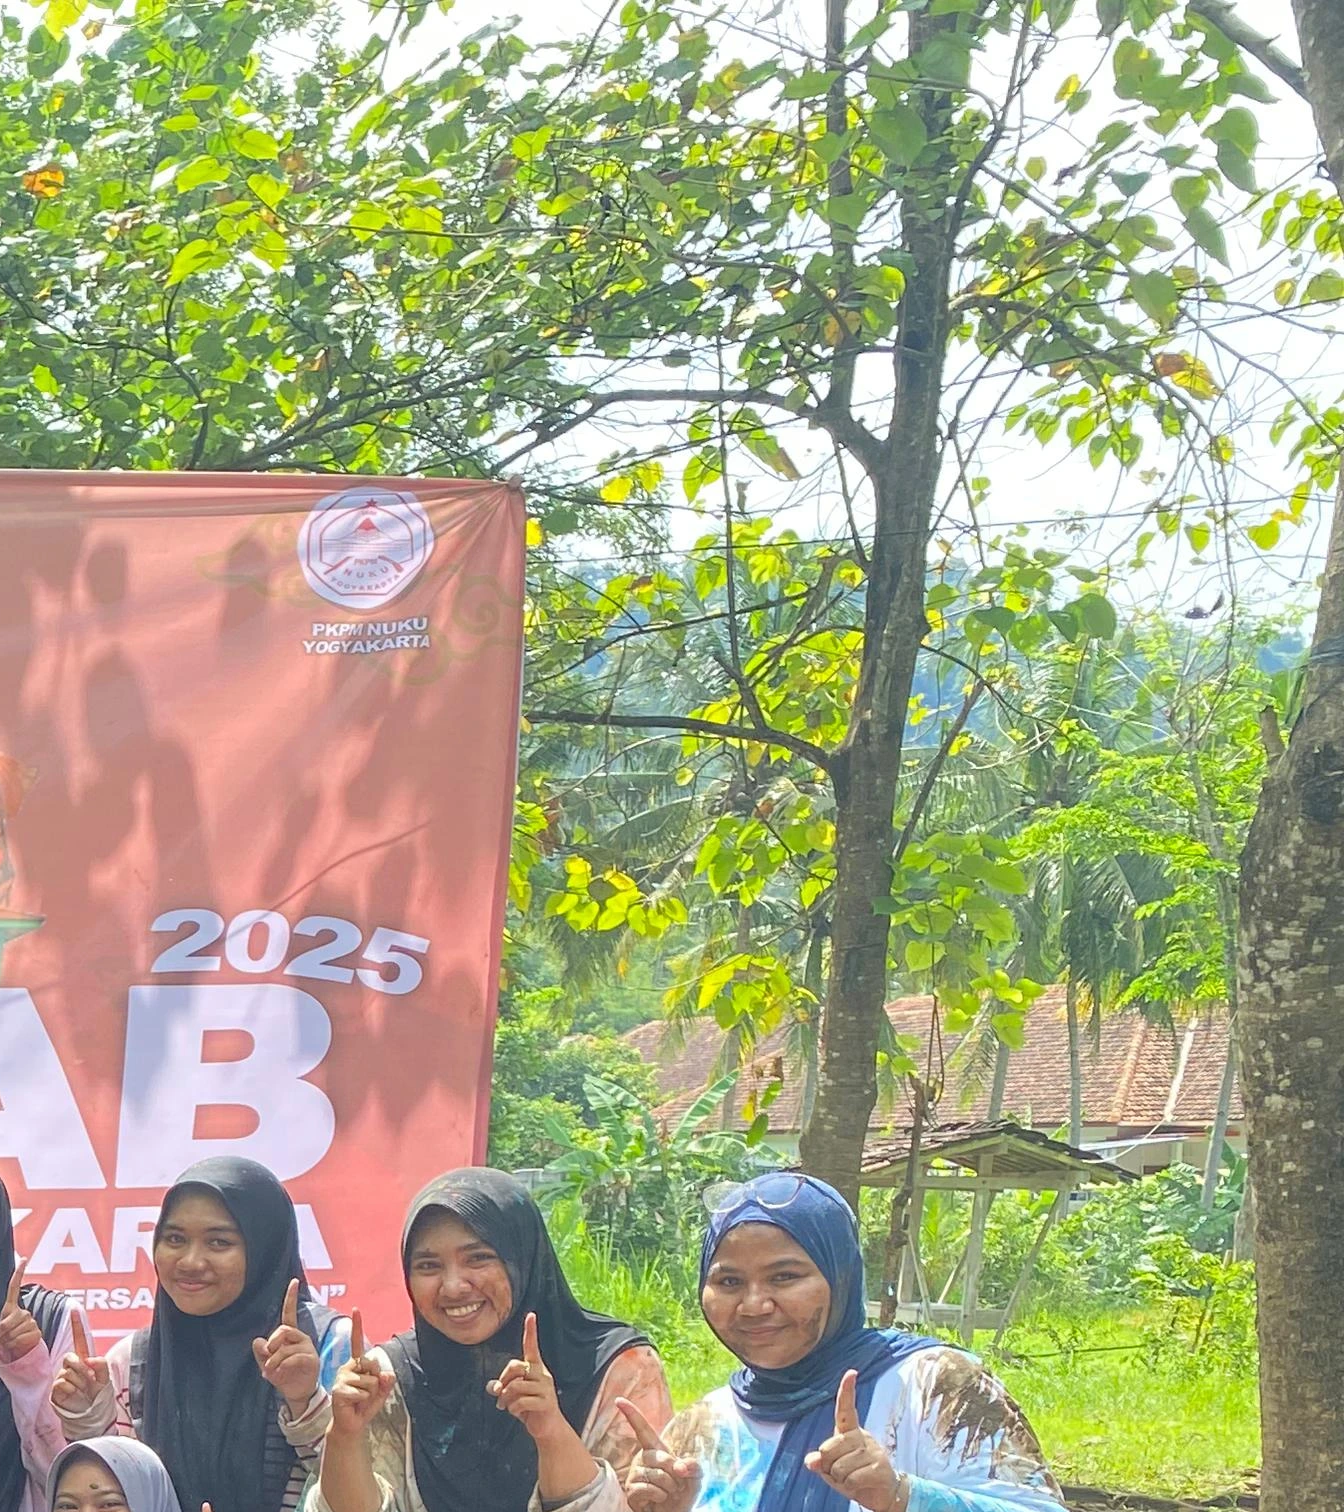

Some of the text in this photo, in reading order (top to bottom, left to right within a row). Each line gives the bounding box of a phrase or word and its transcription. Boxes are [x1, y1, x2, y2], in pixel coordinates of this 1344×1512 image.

[312, 617, 428, 637] PKPM NUKU
[303, 634, 430, 655] YOGYAKARTA
[149, 908, 431, 996] 2025
